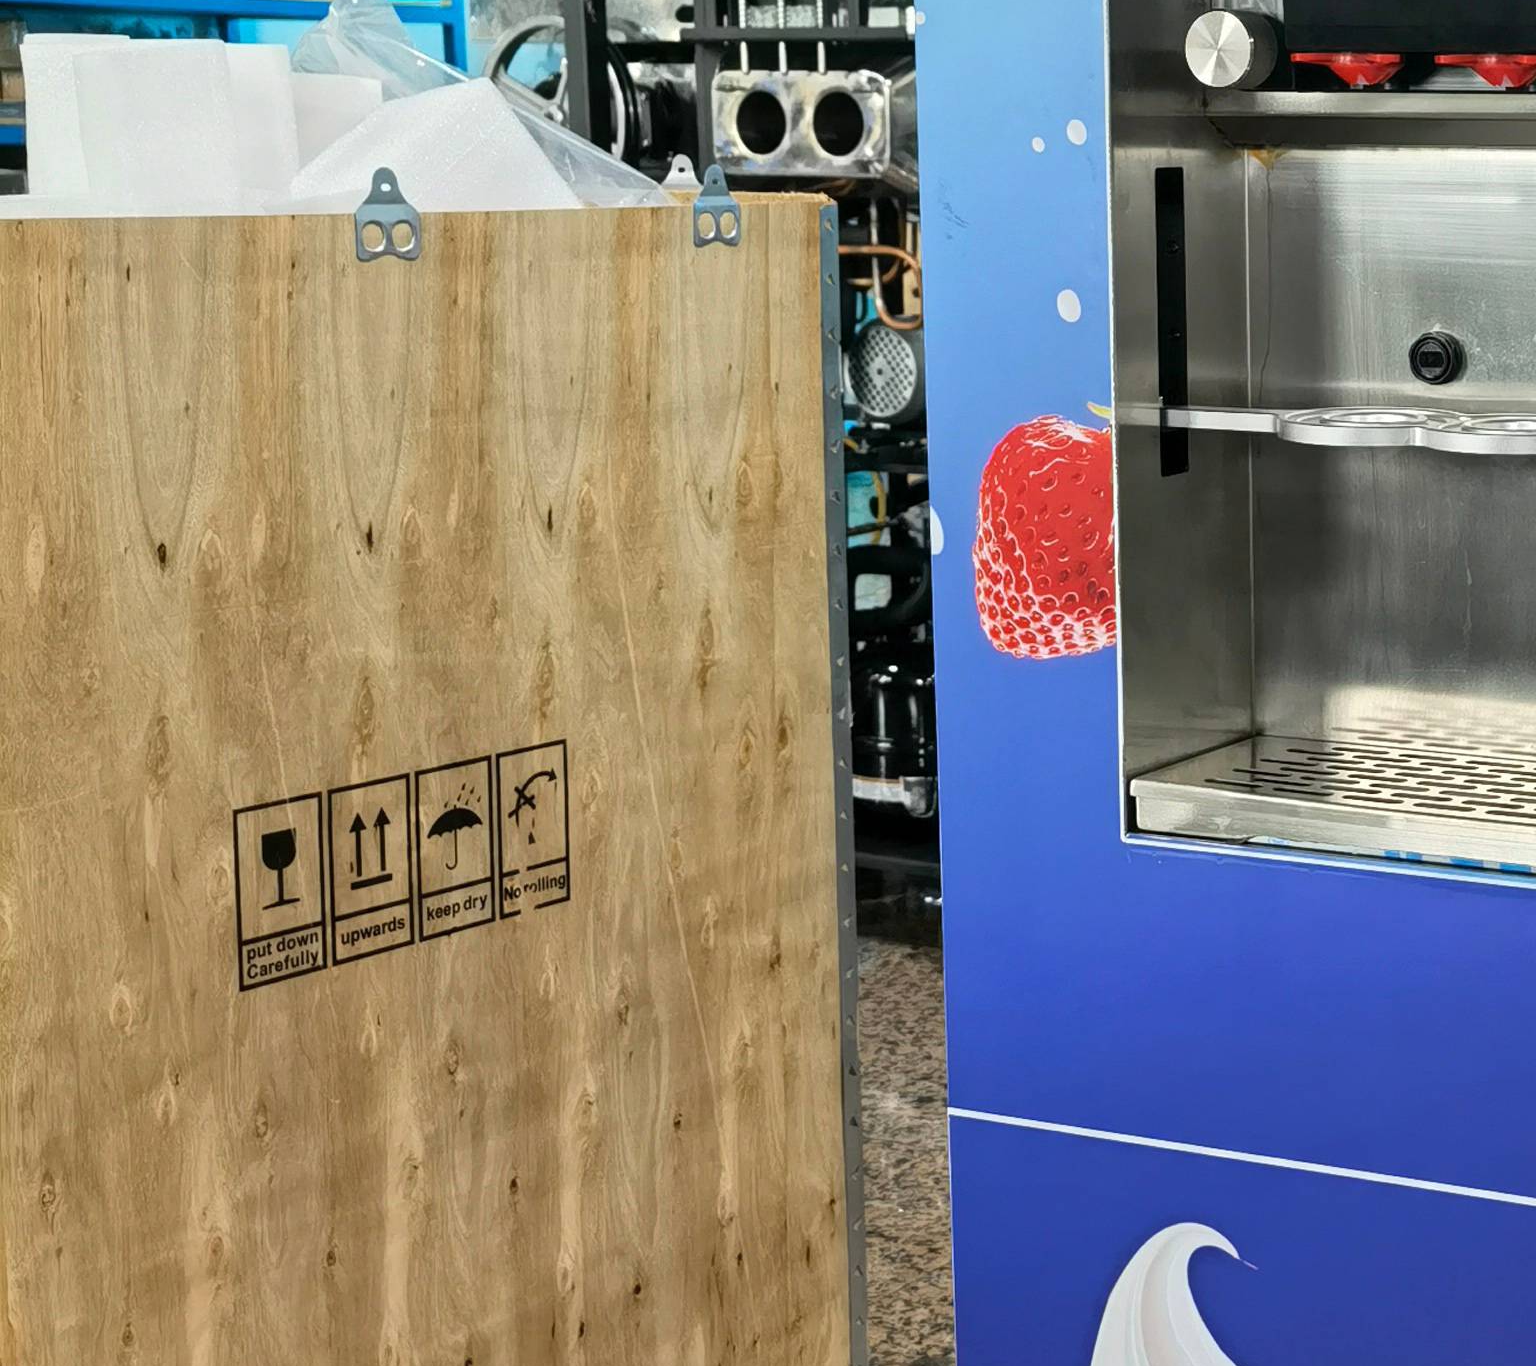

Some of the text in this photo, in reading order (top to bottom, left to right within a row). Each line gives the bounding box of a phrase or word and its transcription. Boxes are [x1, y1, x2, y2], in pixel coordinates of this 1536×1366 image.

[504, 875, 566, 901] No rolling
[426, 894, 488, 921] keep dry
[341, 917, 405, 947] upwards
[247, 931, 319, 964] put down
[247, 950, 319, 979] Carefully
